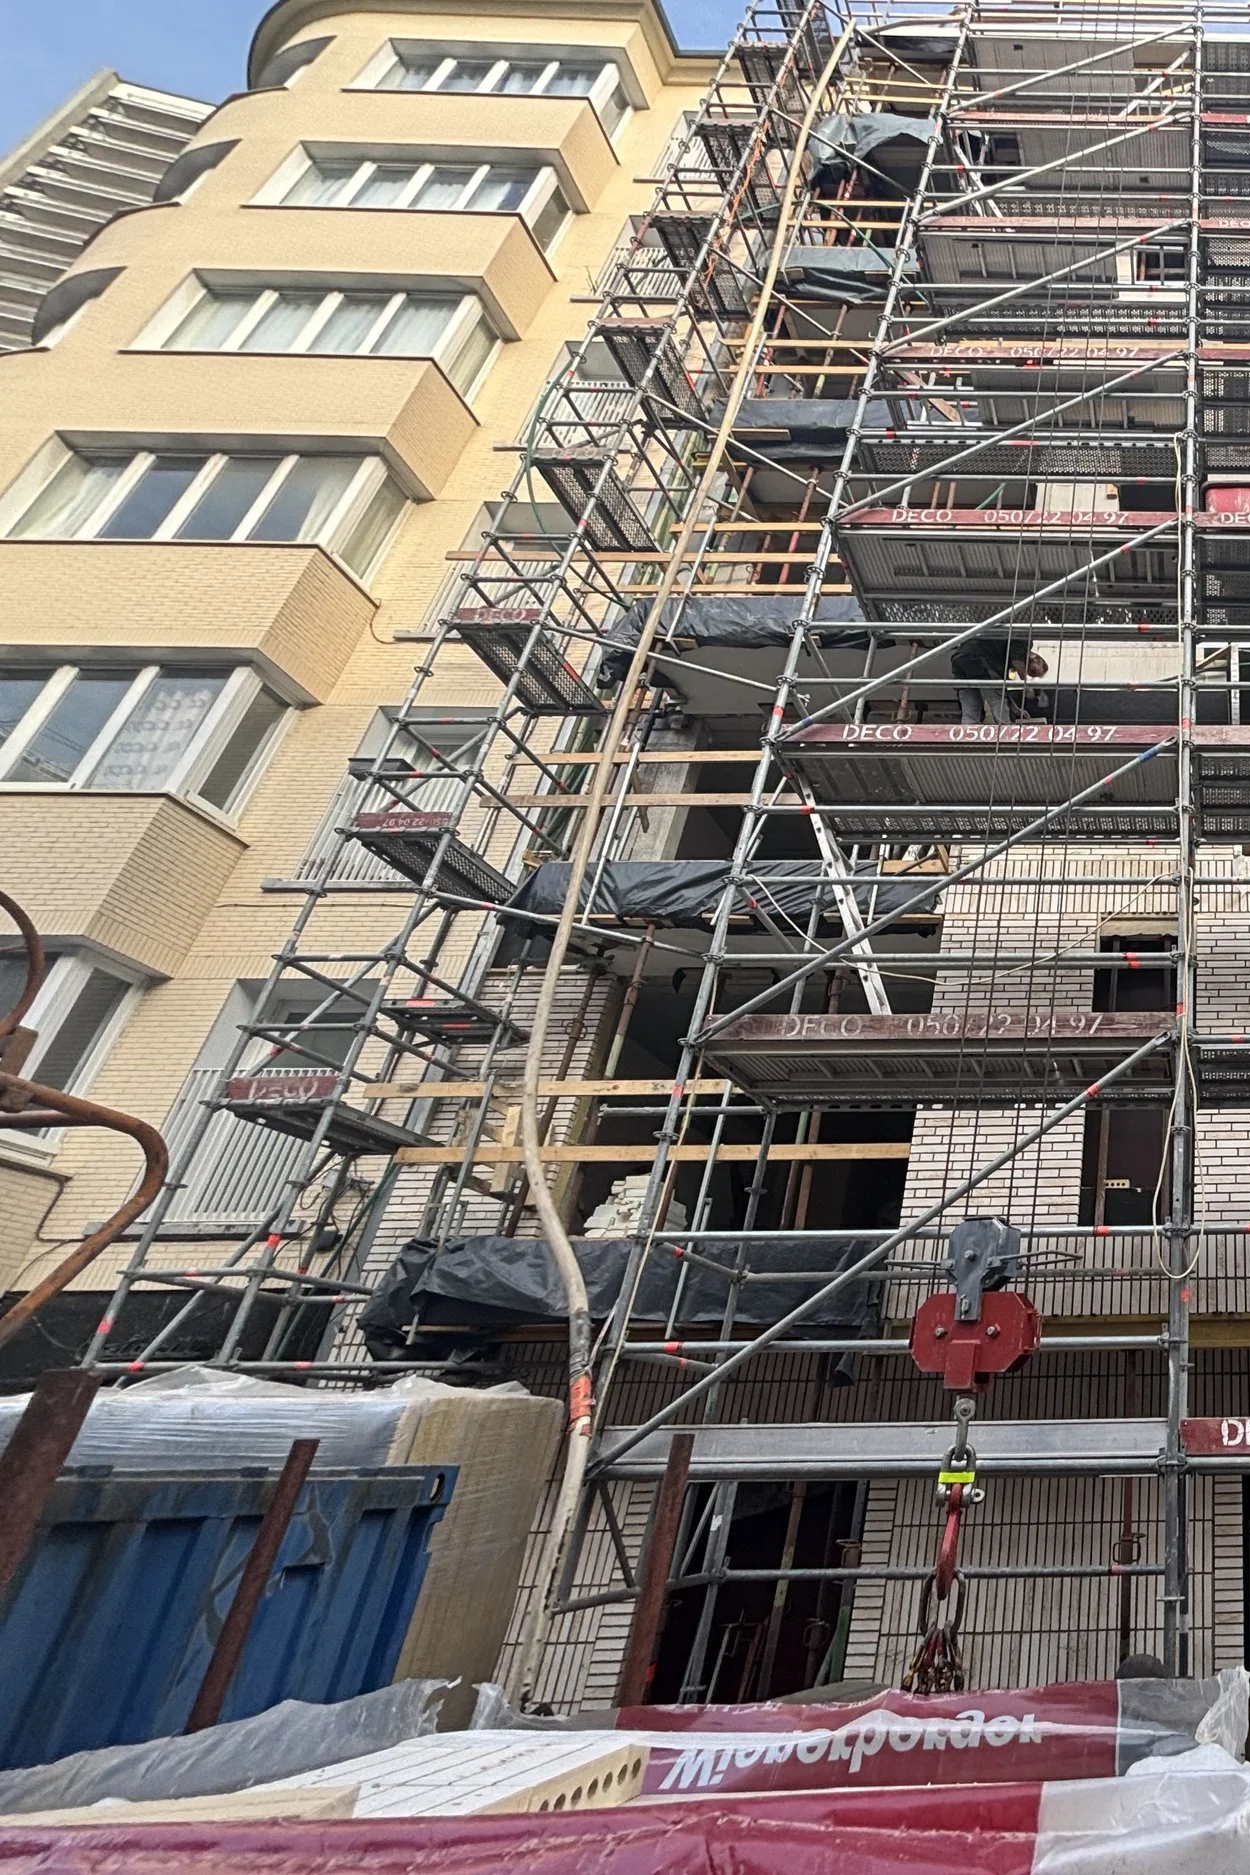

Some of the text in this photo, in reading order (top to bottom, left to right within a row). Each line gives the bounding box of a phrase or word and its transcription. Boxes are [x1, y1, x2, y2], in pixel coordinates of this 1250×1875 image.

[930, 346, 983, 357] DECO
[1116, 347, 1139, 358] 97
[892, 509, 1128, 524] DECO 050/22 04 97
[842, 724, 1118, 741] DECO 050/22 04 97
